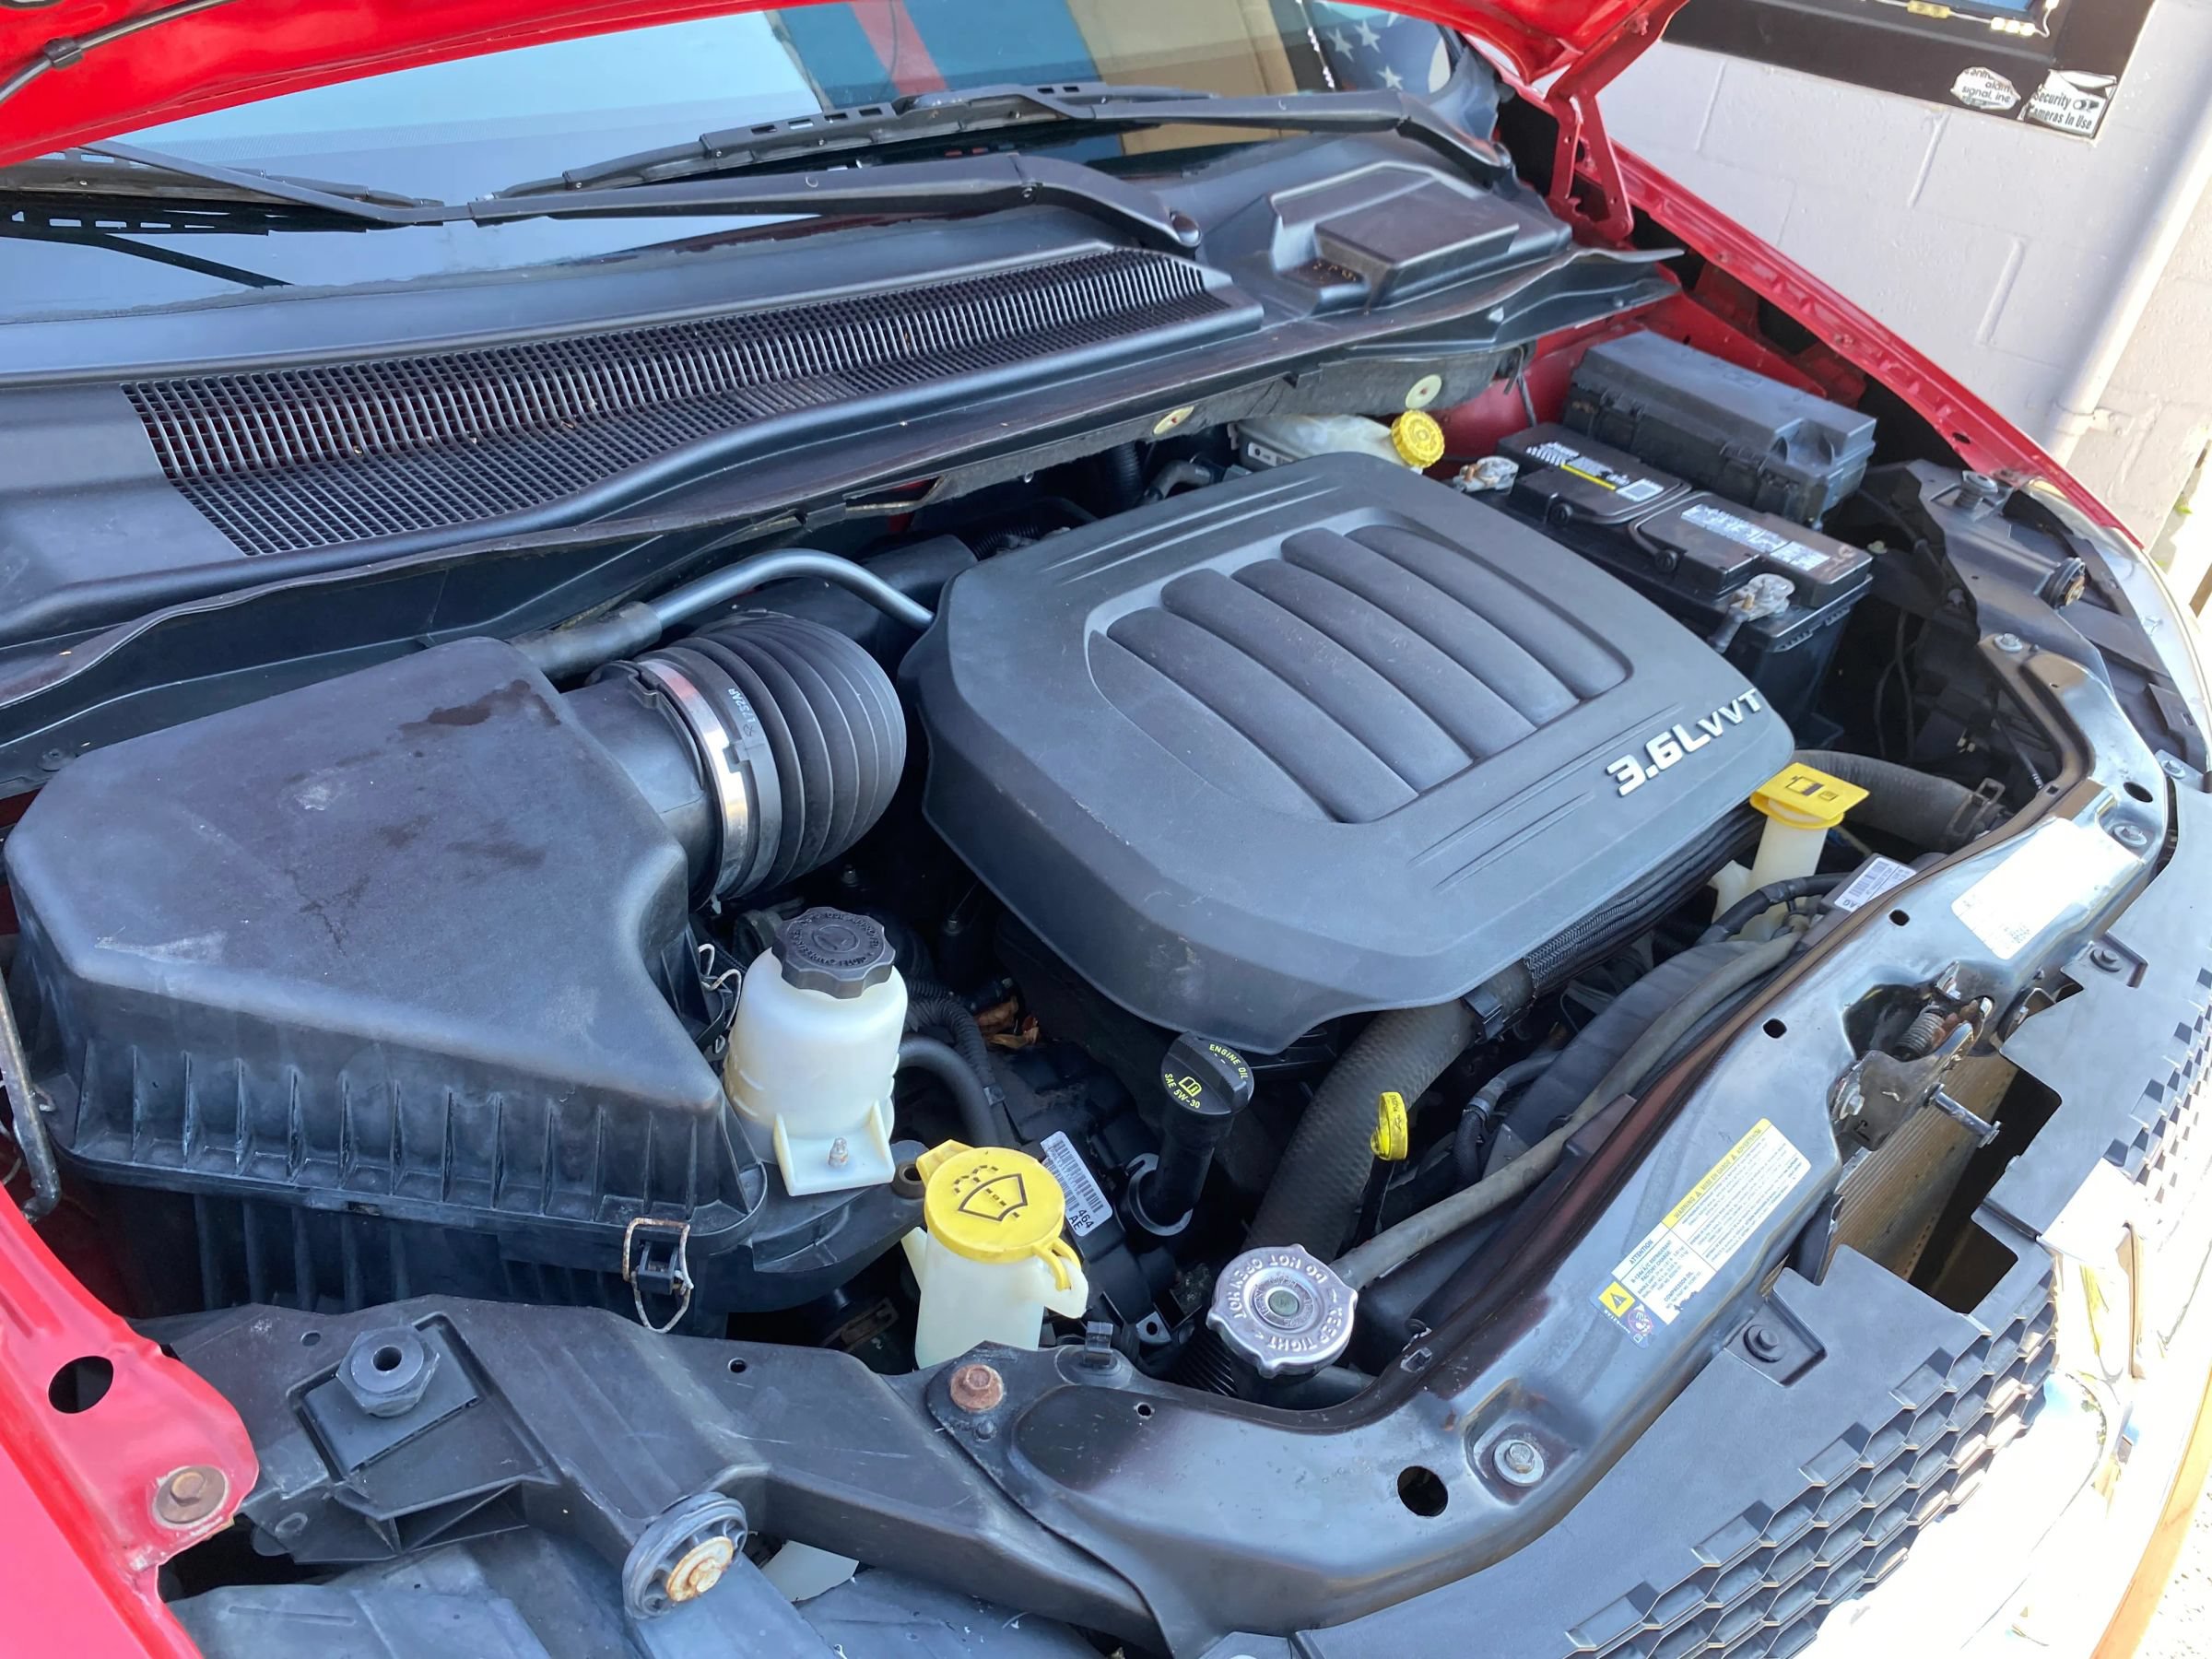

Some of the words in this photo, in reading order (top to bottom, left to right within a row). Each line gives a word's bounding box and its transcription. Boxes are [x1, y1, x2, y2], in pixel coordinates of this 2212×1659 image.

[2076, 115, 2092, 130] Use
[1209, 1043, 1241, 1065] ENGINE
[1238, 1067, 1248, 1079] OIL
[1164, 1073, 1177, 1088] SAE
[1173, 1088, 1201, 1109] 5W-30
[1068, 1216, 1084, 1231] AE
[1077, 1209, 1094, 1229] 464
[1269, 1253, 1301, 1269] NOT
[1629, 1239, 1653, 1265] ATTENTION
[1232, 1257, 1264, 1289] OPEN
[1306, 1265, 1328, 1284] DO
[1227, 1291, 1247, 1319] HOT
[1320, 1307, 1343, 1345] KEEP
[1266, 1335, 1318, 1352] TIGHT
